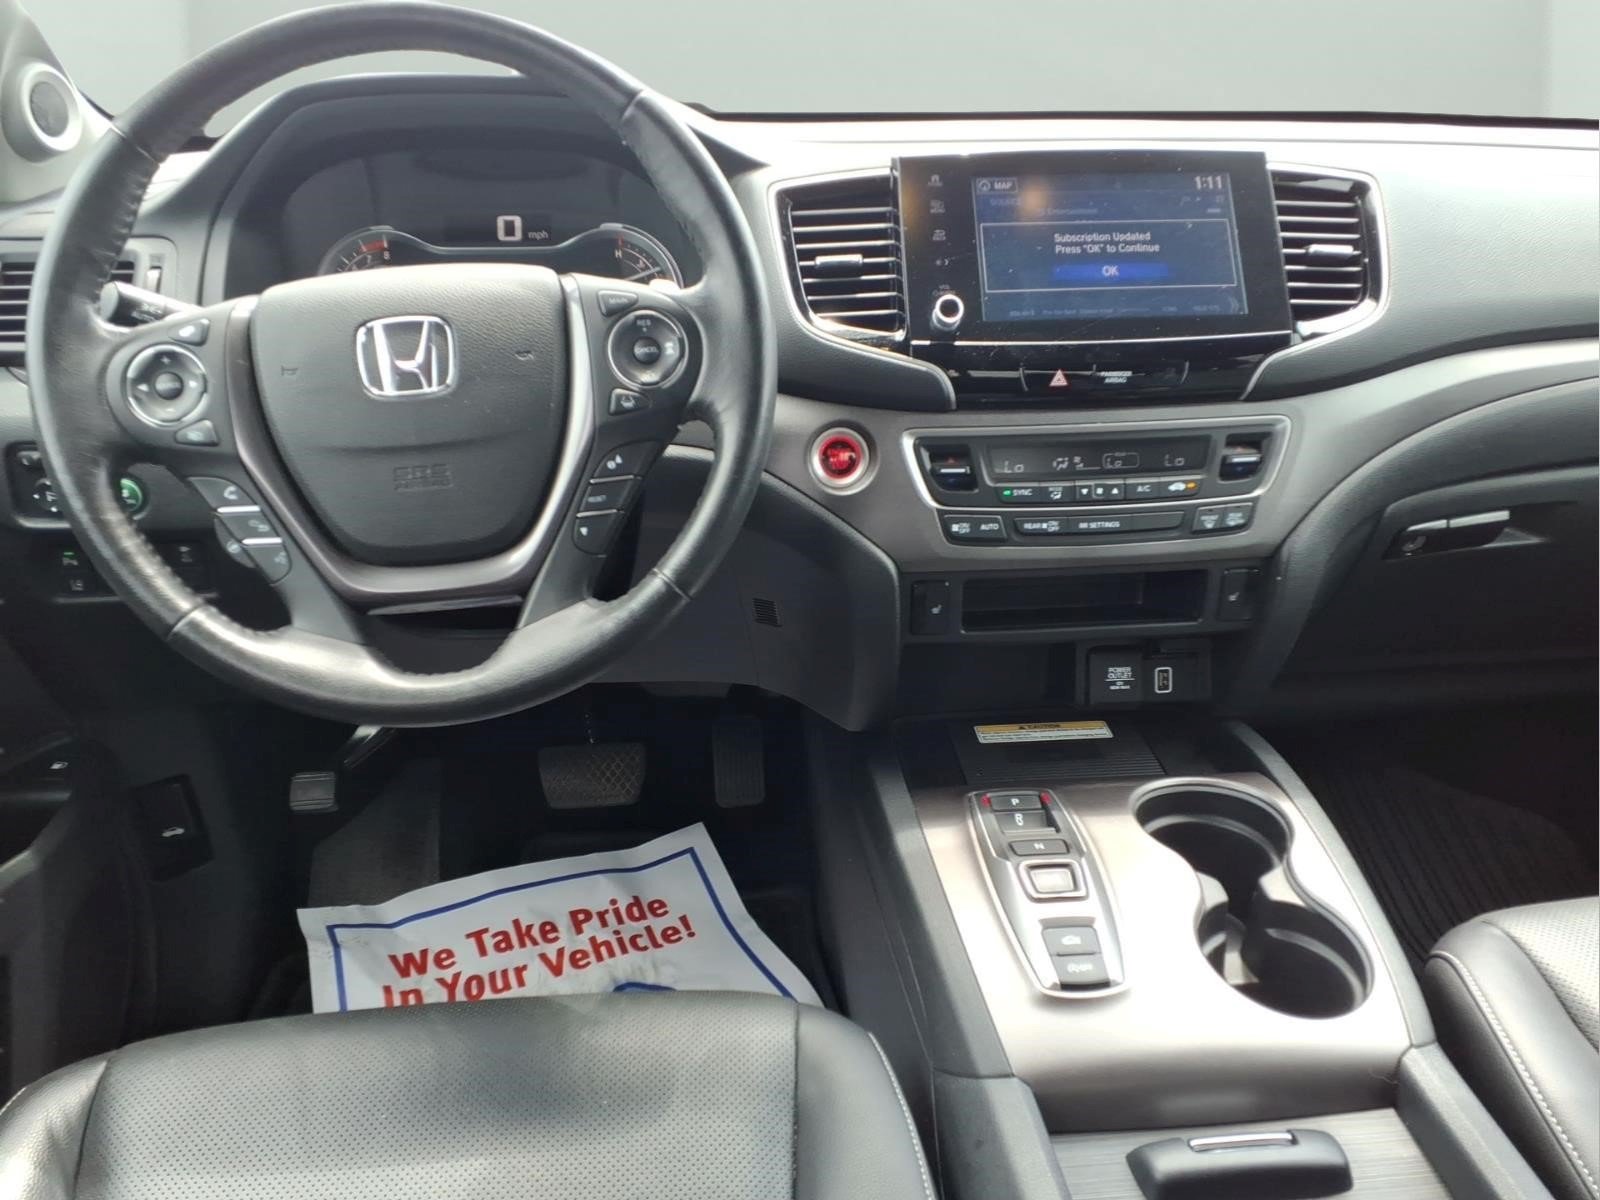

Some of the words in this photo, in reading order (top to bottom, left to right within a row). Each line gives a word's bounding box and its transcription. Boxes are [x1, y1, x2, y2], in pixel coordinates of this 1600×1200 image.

[994, 181, 1013, 190] MAP
[1193, 176, 1223, 190] 1:11
[496, 214, 523, 242] 0
[528, 230, 549, 240] mph
[1053, 232, 1111, 243] Subscription
[1112, 231, 1151, 243] Updated
[1055, 244, 1082, 254] Press
[1106, 243, 1117, 253] to
[1118, 242, 1160, 253] Continue
[1102, 265, 1119, 277] OK
[1010, 797, 1020, 807] P
[387, 947, 457, 979] We
[464, 918, 561, 958] Take
[568, 895, 670, 936] Pride
[382, 984, 425, 1009] In
[434, 963, 528, 1003] Your
[537, 914, 696, 978] Vehicle!
